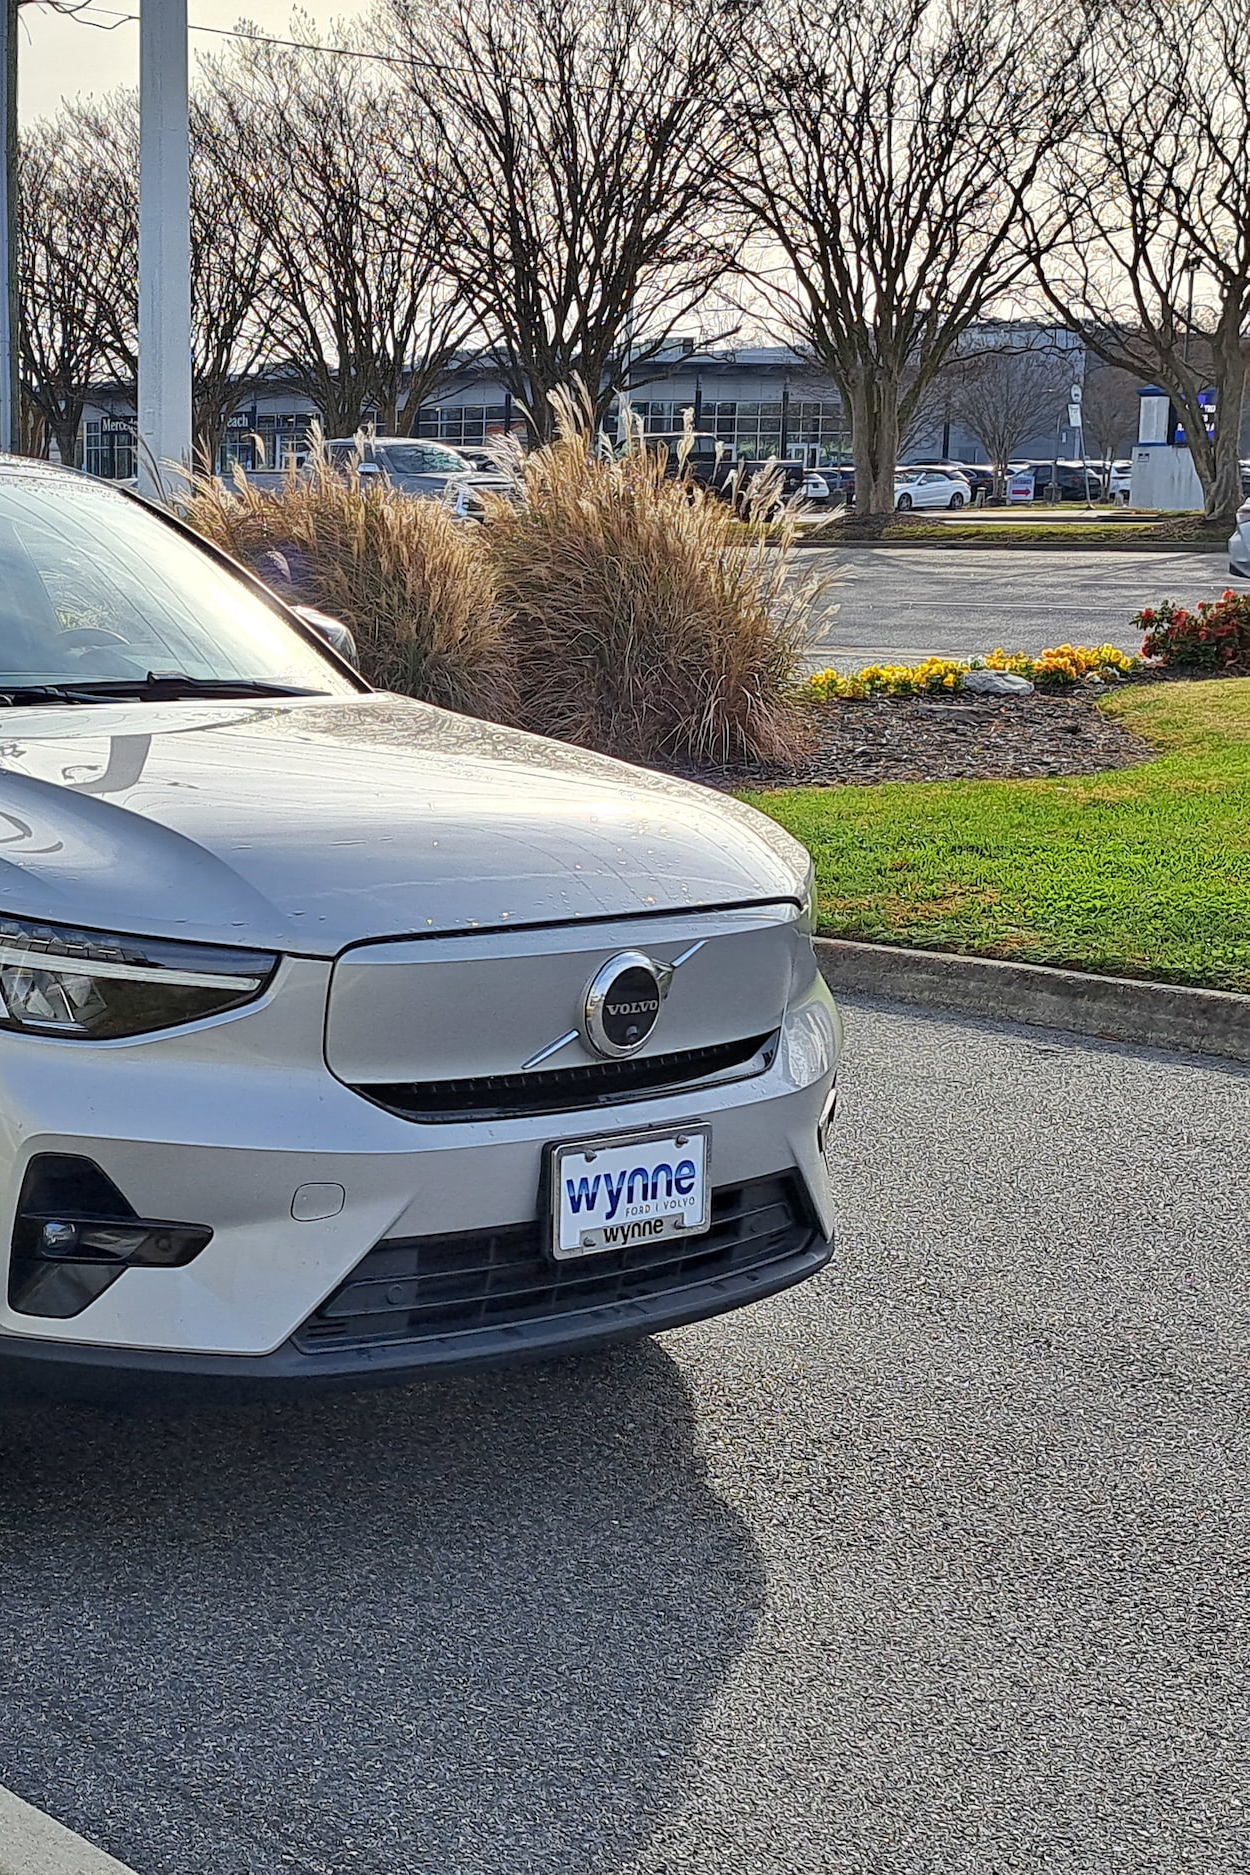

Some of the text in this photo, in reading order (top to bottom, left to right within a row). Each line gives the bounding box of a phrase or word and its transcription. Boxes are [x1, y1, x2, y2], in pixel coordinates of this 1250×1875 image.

[605, 999, 658, 1016] VOLVO
[566, 1159, 696, 1220] wynne
[625, 1203, 650, 1218] FORD
[663, 1196, 696, 1210] VOLVO
[603, 1218, 664, 1245] wynne
